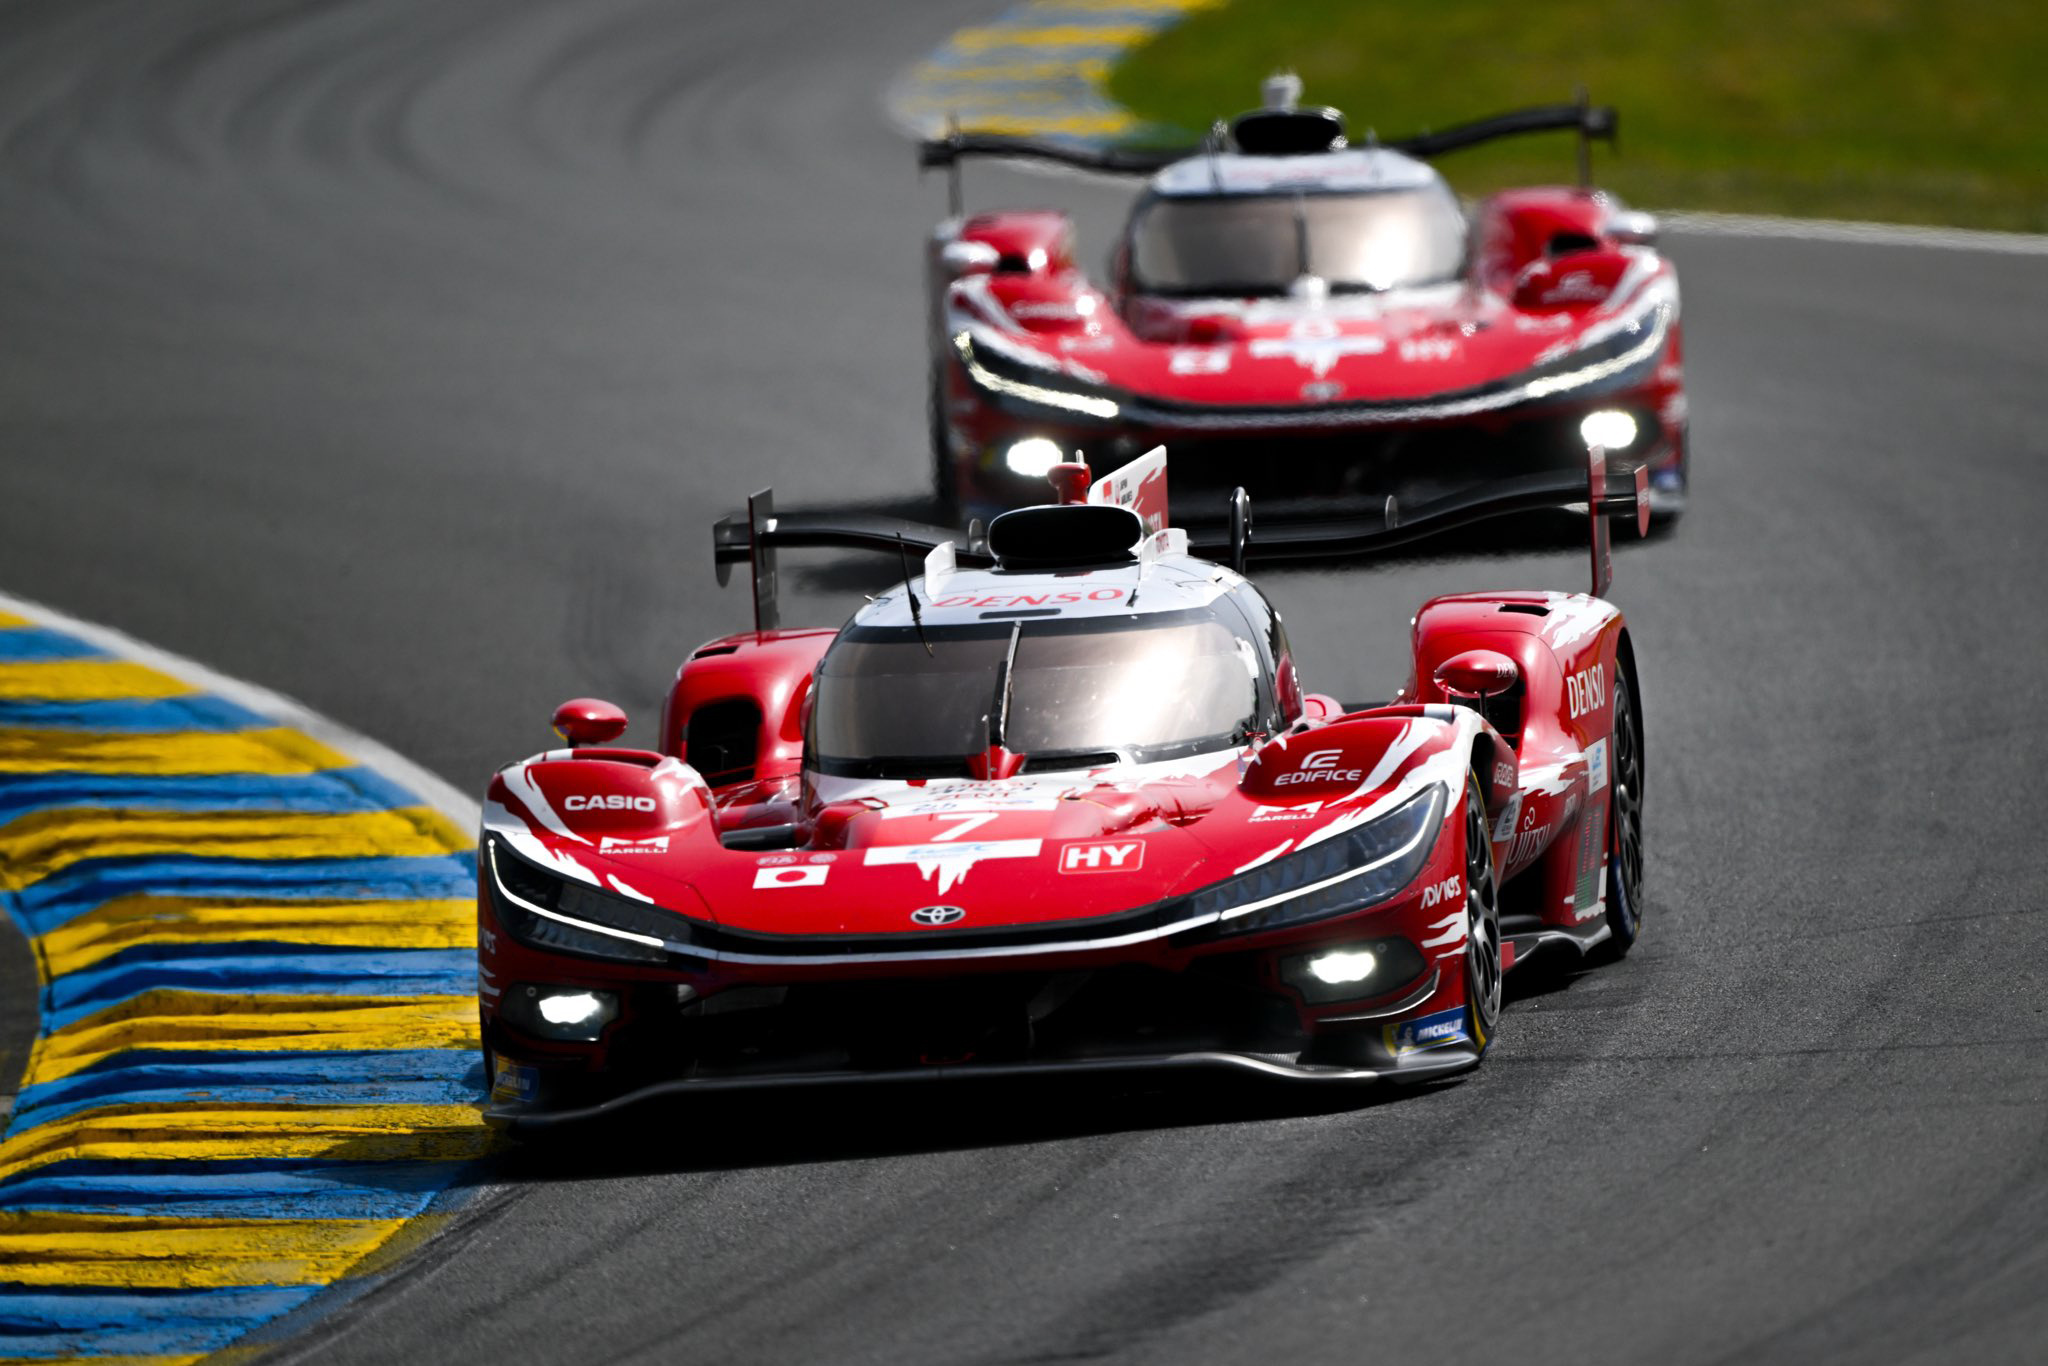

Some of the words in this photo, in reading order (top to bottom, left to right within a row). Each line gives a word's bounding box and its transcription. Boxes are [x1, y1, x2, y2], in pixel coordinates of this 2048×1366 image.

[931, 588, 1124, 608] DENSO
[1566, 661, 1606, 720] DENSO
[1273, 768, 1363, 787] EDIFICE
[564, 794, 657, 813] CASIO
[929, 811, 1000, 842] 7
[1247, 813, 1316, 823] MARELLI
[599, 847, 669, 855] MARELLI
[1065, 843, 1138, 869] HY
[1507, 822, 1552, 872] UJITSU
[1416, 1018, 1464, 1042] MICHELIN
